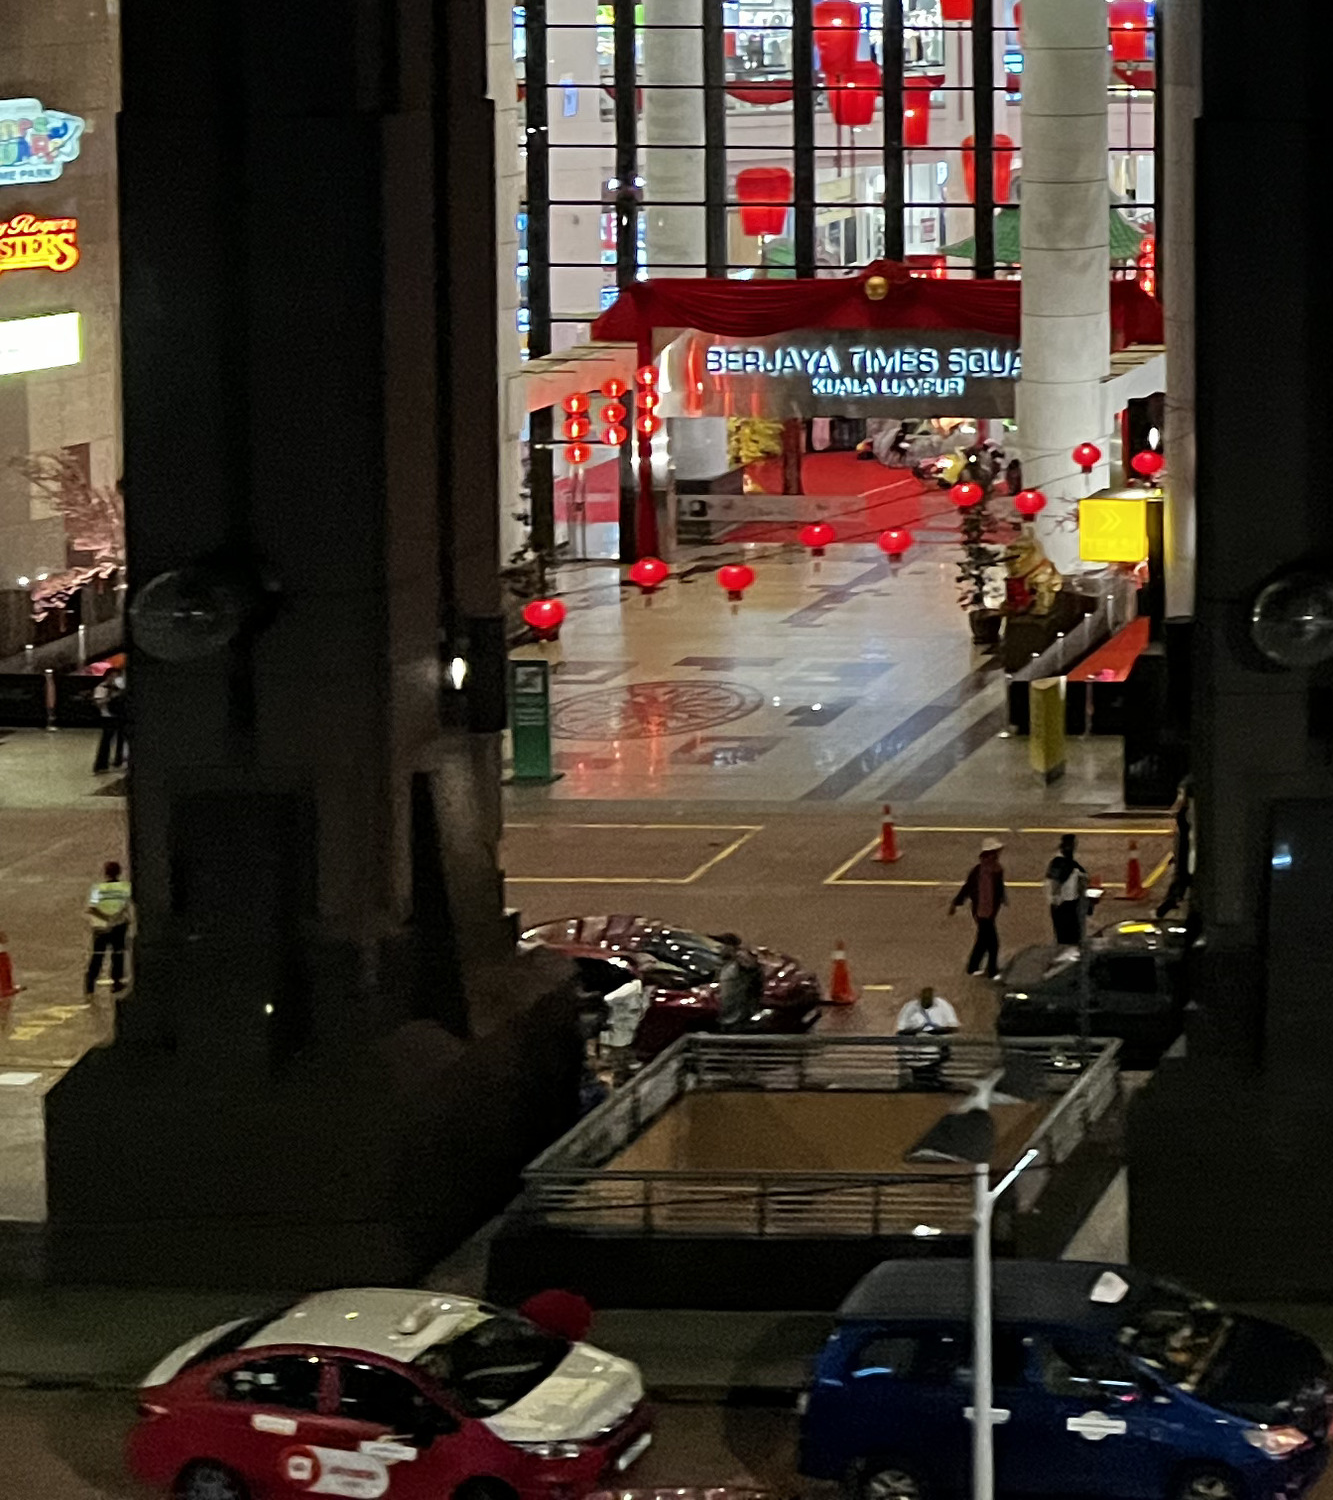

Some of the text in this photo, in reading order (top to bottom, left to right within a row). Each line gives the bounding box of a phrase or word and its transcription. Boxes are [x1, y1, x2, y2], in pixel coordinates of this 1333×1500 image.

[706, 345, 841, 376] BERJAYA
[849, 345, 940, 375] TIMES
[811, 376, 966, 397] KUALA LUMPUR
